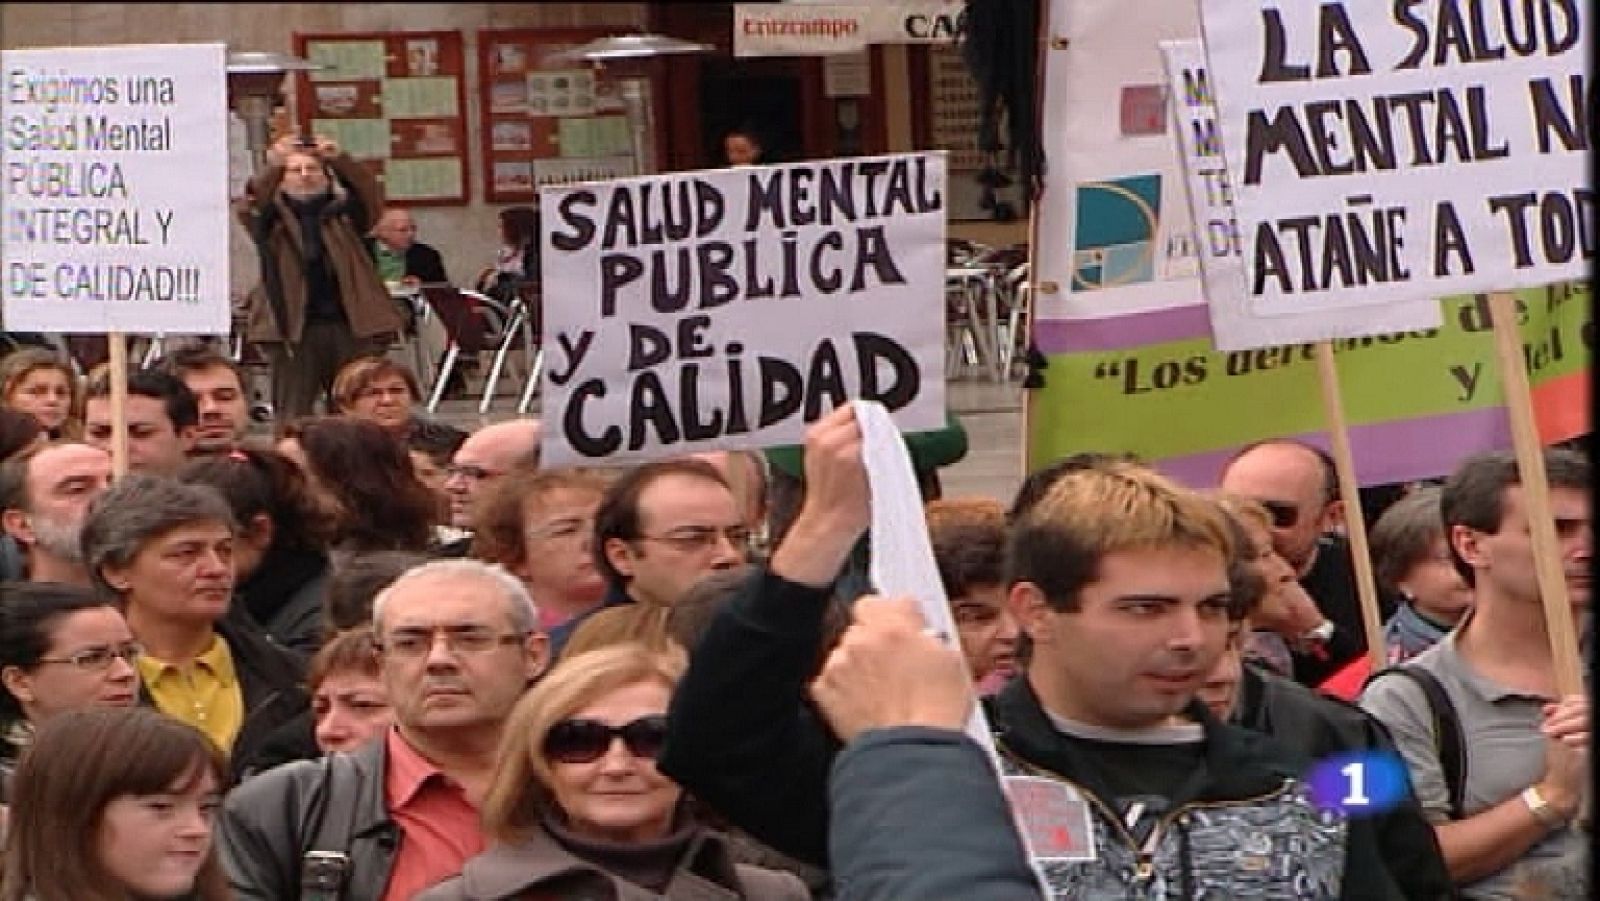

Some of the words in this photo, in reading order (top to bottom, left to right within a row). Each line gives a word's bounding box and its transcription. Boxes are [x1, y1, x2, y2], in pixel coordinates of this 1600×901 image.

[1257, 2, 1372, 84] LA
[1392, 0, 1580, 71] SALUD
[10, 68, 120, 113] Exigimos
[126, 75, 175, 105] una
[9, 114, 78, 151] Salud
[84, 114, 171, 151] Mental
[1243, 86, 1510, 186] MENTAL
[9, 156, 127, 198] PÚBLICA
[550, 179, 726, 251] SALUD
[744, 155, 942, 232] MENTAL
[9, 207, 151, 245] INTEGRAL
[155, 207, 174, 245] Y
[1252, 194, 1411, 296] ATAÑE
[1433, 201, 1475, 276] A
[9, 261, 47, 297] DE
[55, 262, 200, 302] CALIDAD!!!
[627, 314, 715, 373] DE
[1449, 362, 1482, 402] y
